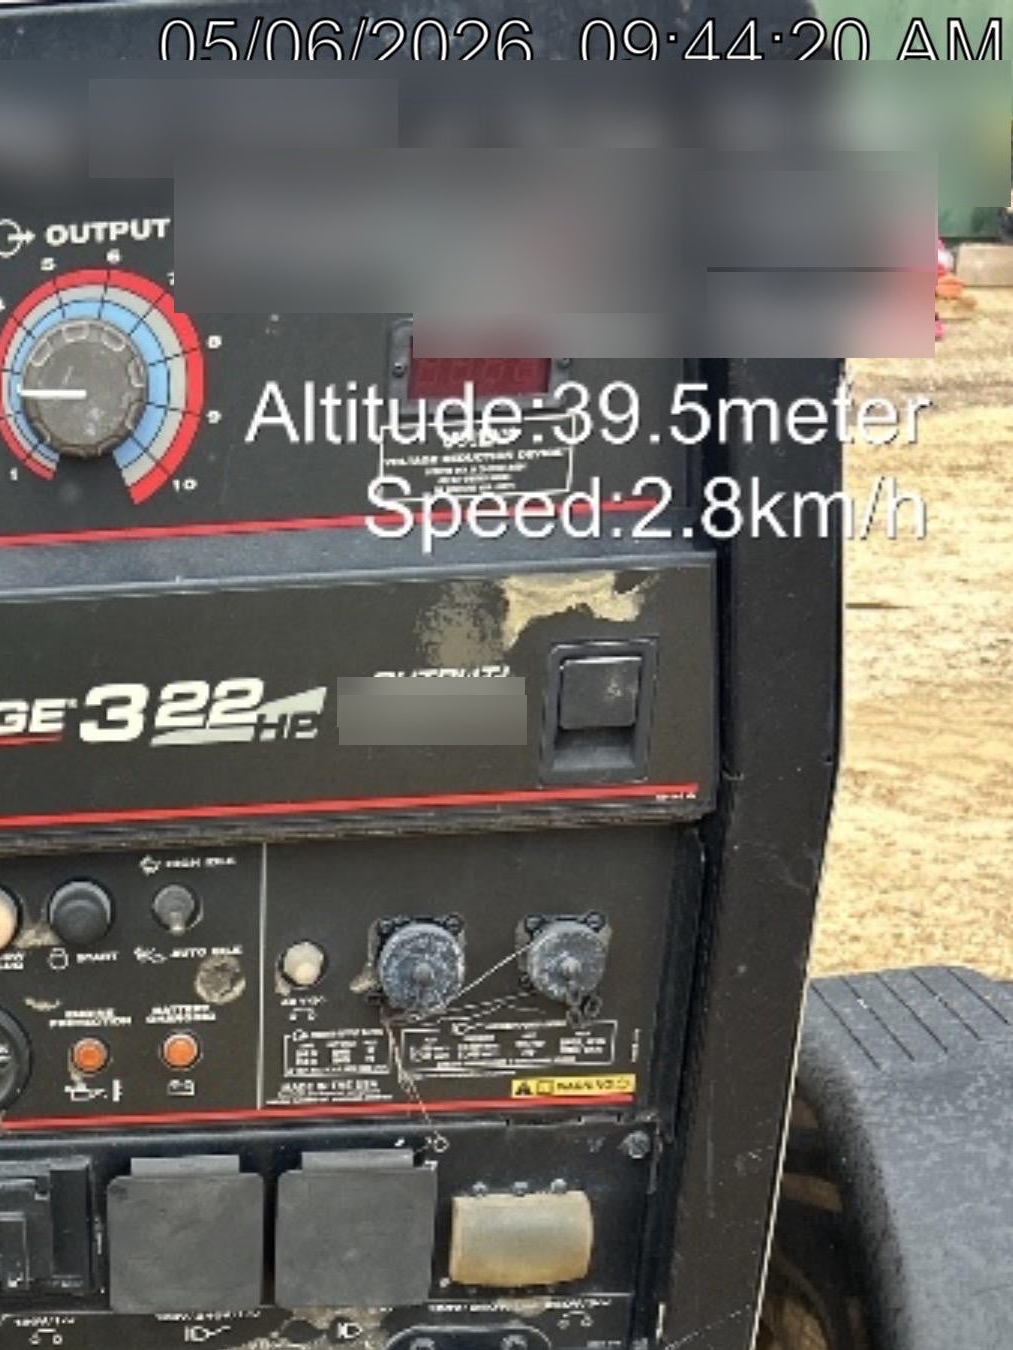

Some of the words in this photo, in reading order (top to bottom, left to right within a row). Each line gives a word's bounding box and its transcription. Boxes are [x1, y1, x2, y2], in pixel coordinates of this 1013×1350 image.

[45, 218, 171, 245] OUTPUT
[106, 250, 122, 264] 6
[40, 258, 56, 272] 5
[207, 410, 221, 423] 9
[9, 468, 19, 480] 1
[172, 478, 197, 491] 10
[79, 677, 265, 743] 322
